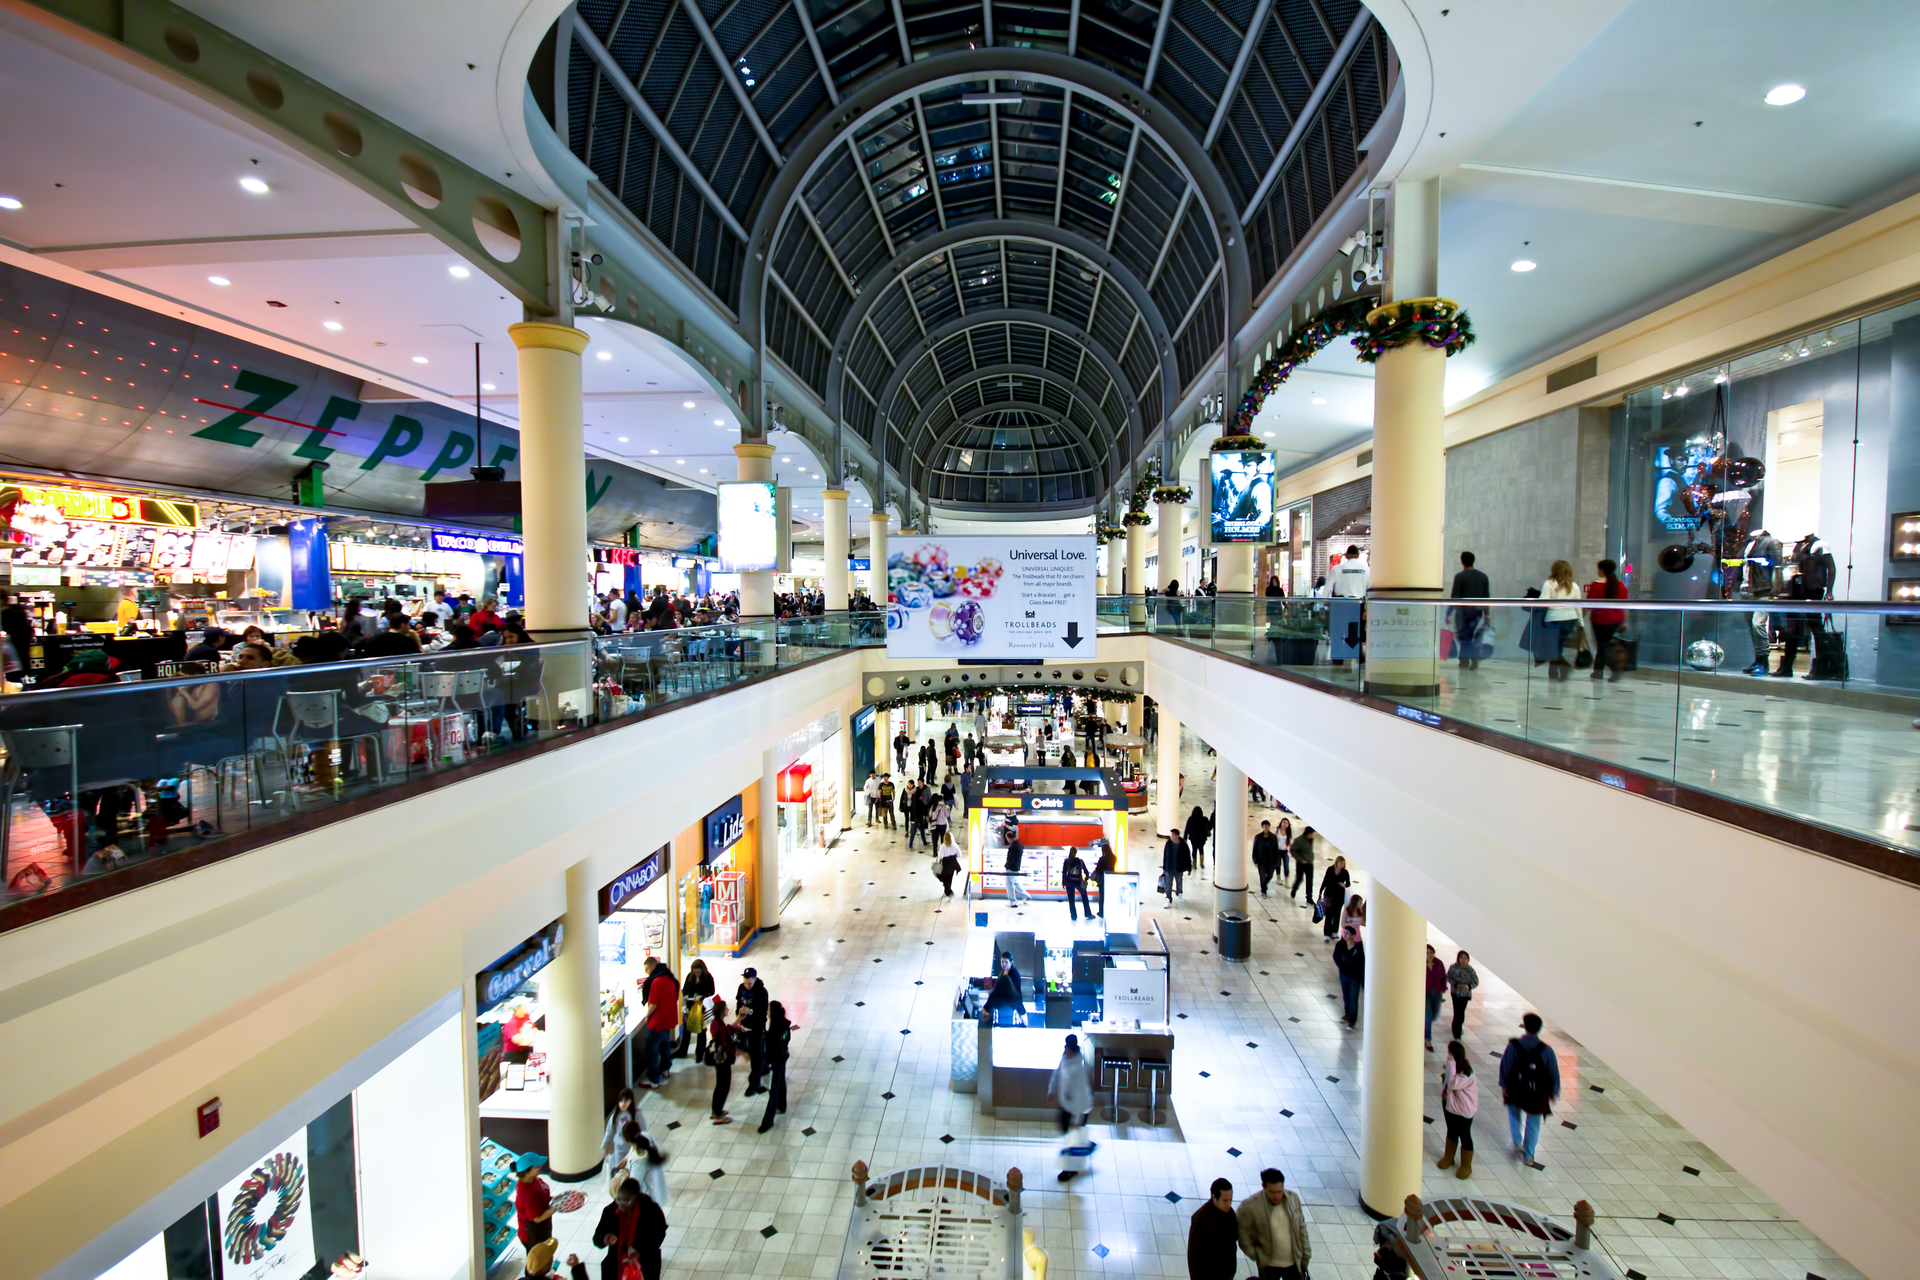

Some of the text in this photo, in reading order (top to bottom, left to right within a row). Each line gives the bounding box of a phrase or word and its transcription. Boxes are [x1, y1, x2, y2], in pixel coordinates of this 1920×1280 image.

[190, 369, 612, 512] ZEPPEN
[435, 534, 476, 550] TACO
[611, 548, 636, 567] KFC
[1009, 549, 1087, 560] Universal Love.
[1005, 621, 1057, 629] TROLLBEADS
[723, 812, 745, 848] Lids
[610, 854, 659, 906] CINNABON
[717, 881, 735, 900] M
[486, 936, 550, 1004] Carvel
